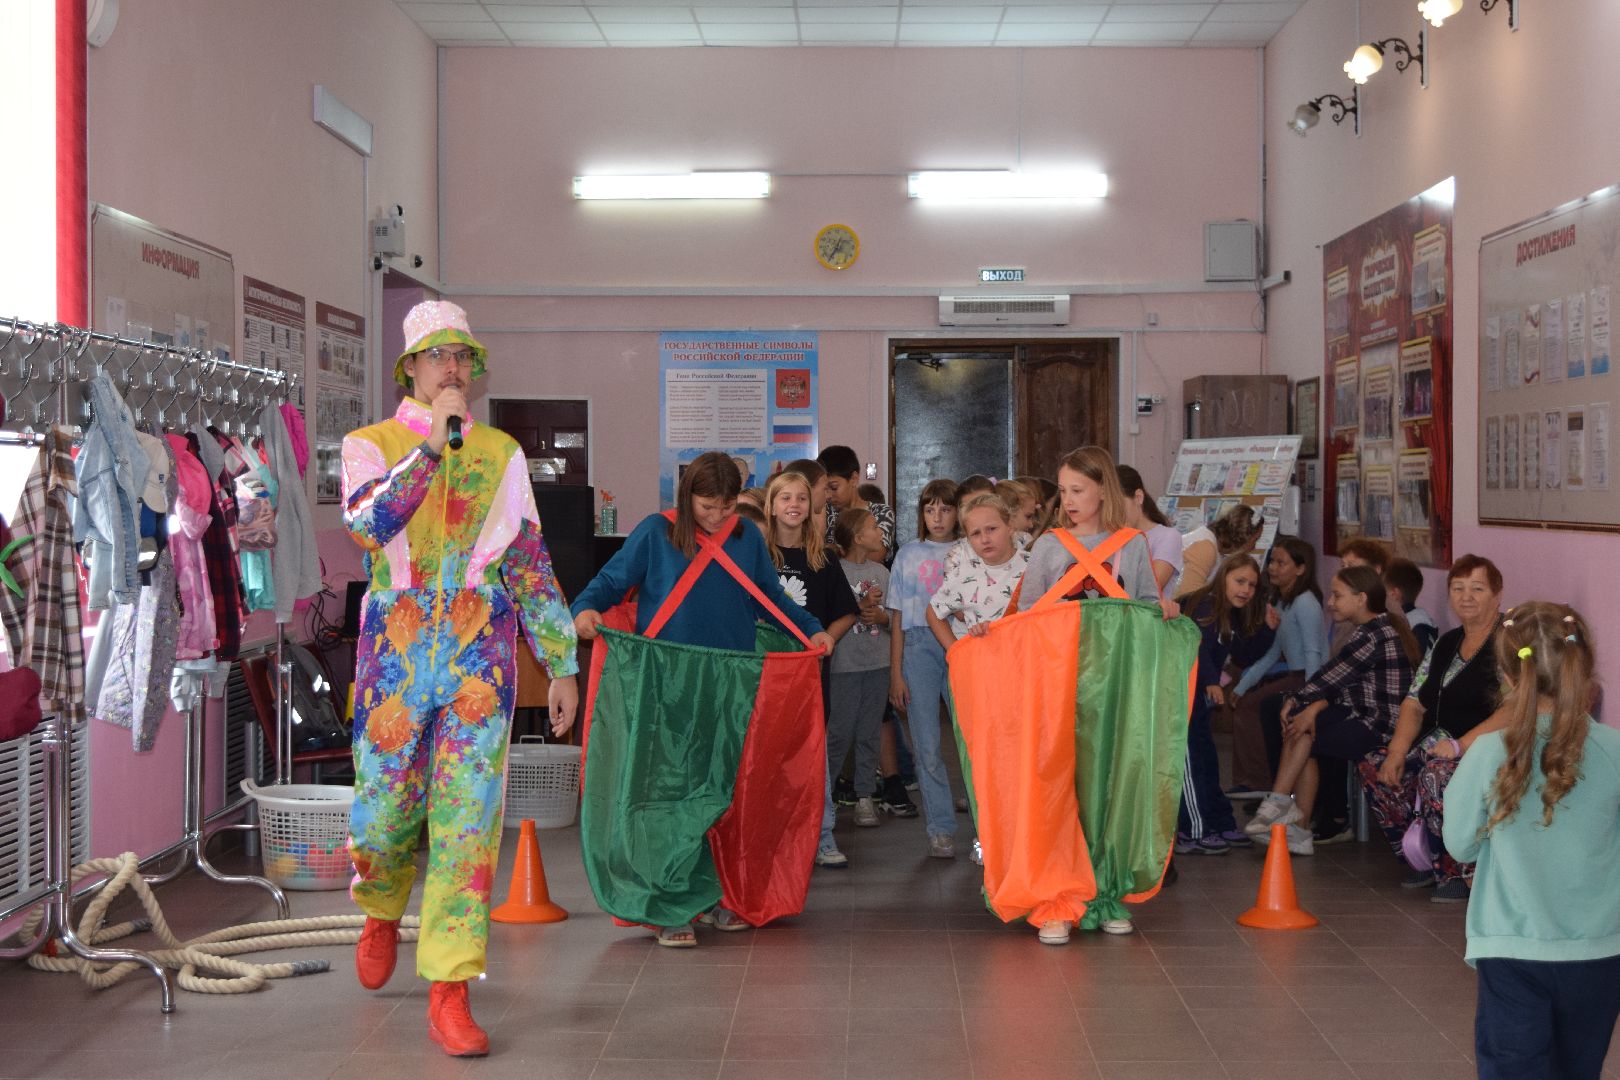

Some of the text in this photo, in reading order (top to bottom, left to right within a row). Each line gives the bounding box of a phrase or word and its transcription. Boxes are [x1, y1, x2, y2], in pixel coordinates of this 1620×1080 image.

[1516, 223, 1576, 267] ДОСТИЖЕНИЯ
[142, 241, 200, 280] ИНФОРМАЦИЯ
[982, 270, 1022, 281] ВЫХОД
[664, 341, 813, 350] ГОСУДАРСТВЕННЫЕ СИМВОЛЫ
[673, 352, 804, 362] РОССИЙСКОЙ ФЕДЕРАЦИИ
